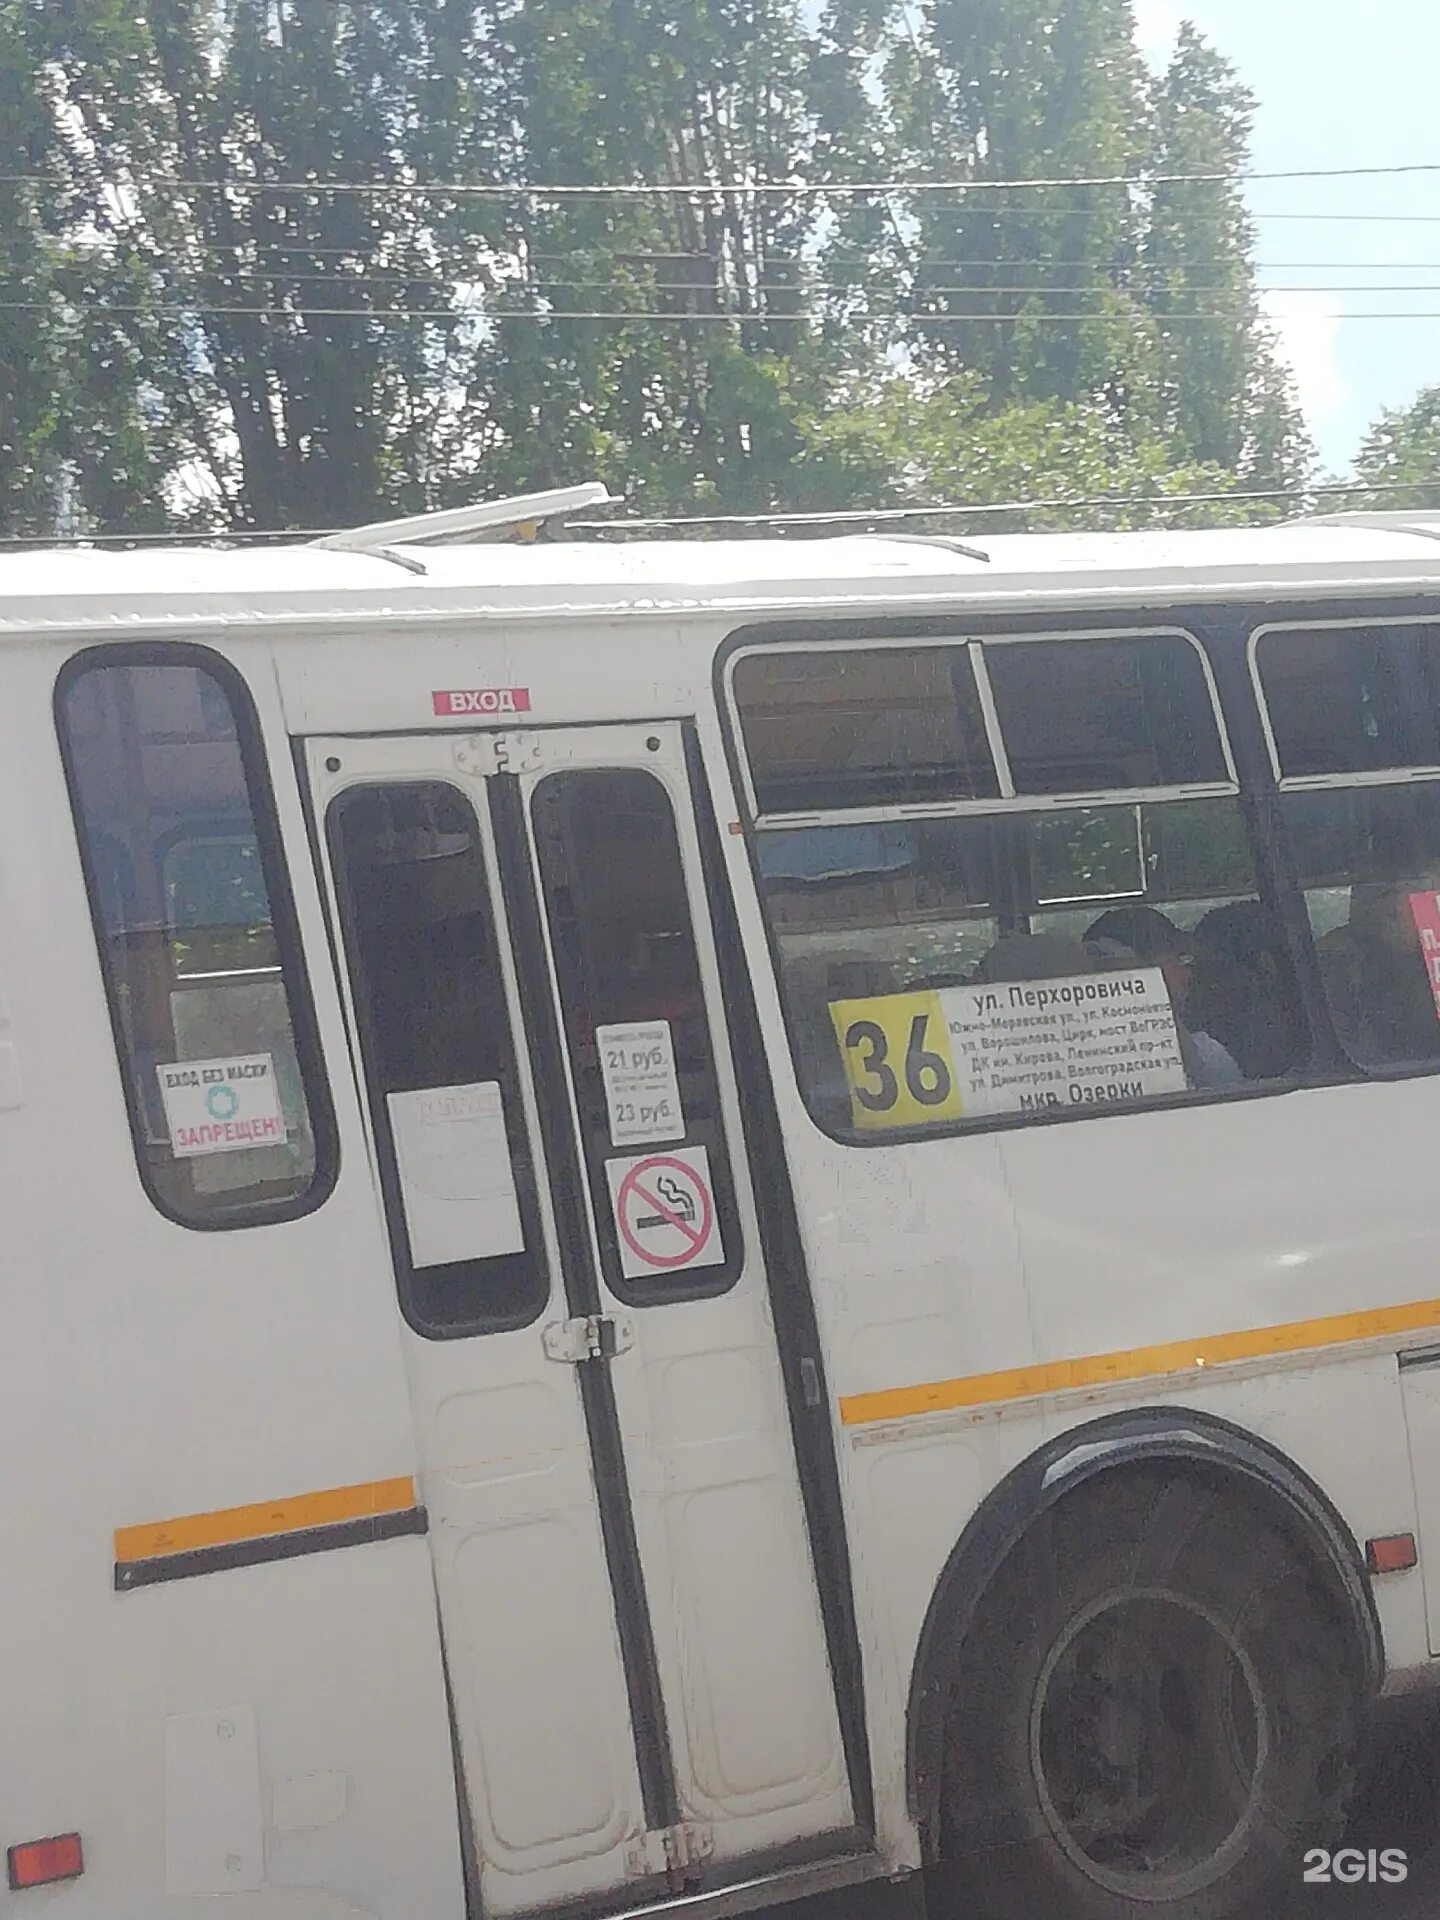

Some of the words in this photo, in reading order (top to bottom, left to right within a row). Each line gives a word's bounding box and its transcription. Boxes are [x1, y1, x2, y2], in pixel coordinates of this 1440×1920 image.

[449, 690, 516, 712] ВХОД
[972, 994, 1004, 1016] ул.
[1008, 979, 1146, 1012] Перхоровича
[1099, 1025, 1127, 1037] мост
[607, 1050, 627, 1069] 21
[845, 1014, 951, 1112] 36
[971, 1057, 990, 1073] ДК
[1067, 1038, 1137, 1060] Ленинский
[166, 1070, 200, 1088] ВХОД
[202, 1069, 224, 1083] БЕЗ
[227, 1064, 267, 1080] МАСКИ
[1067, 1058, 1162, 1079] Волгоградская
[1068, 1080, 1144, 1104] Озерки
[616, 1103, 636, 1122] 23
